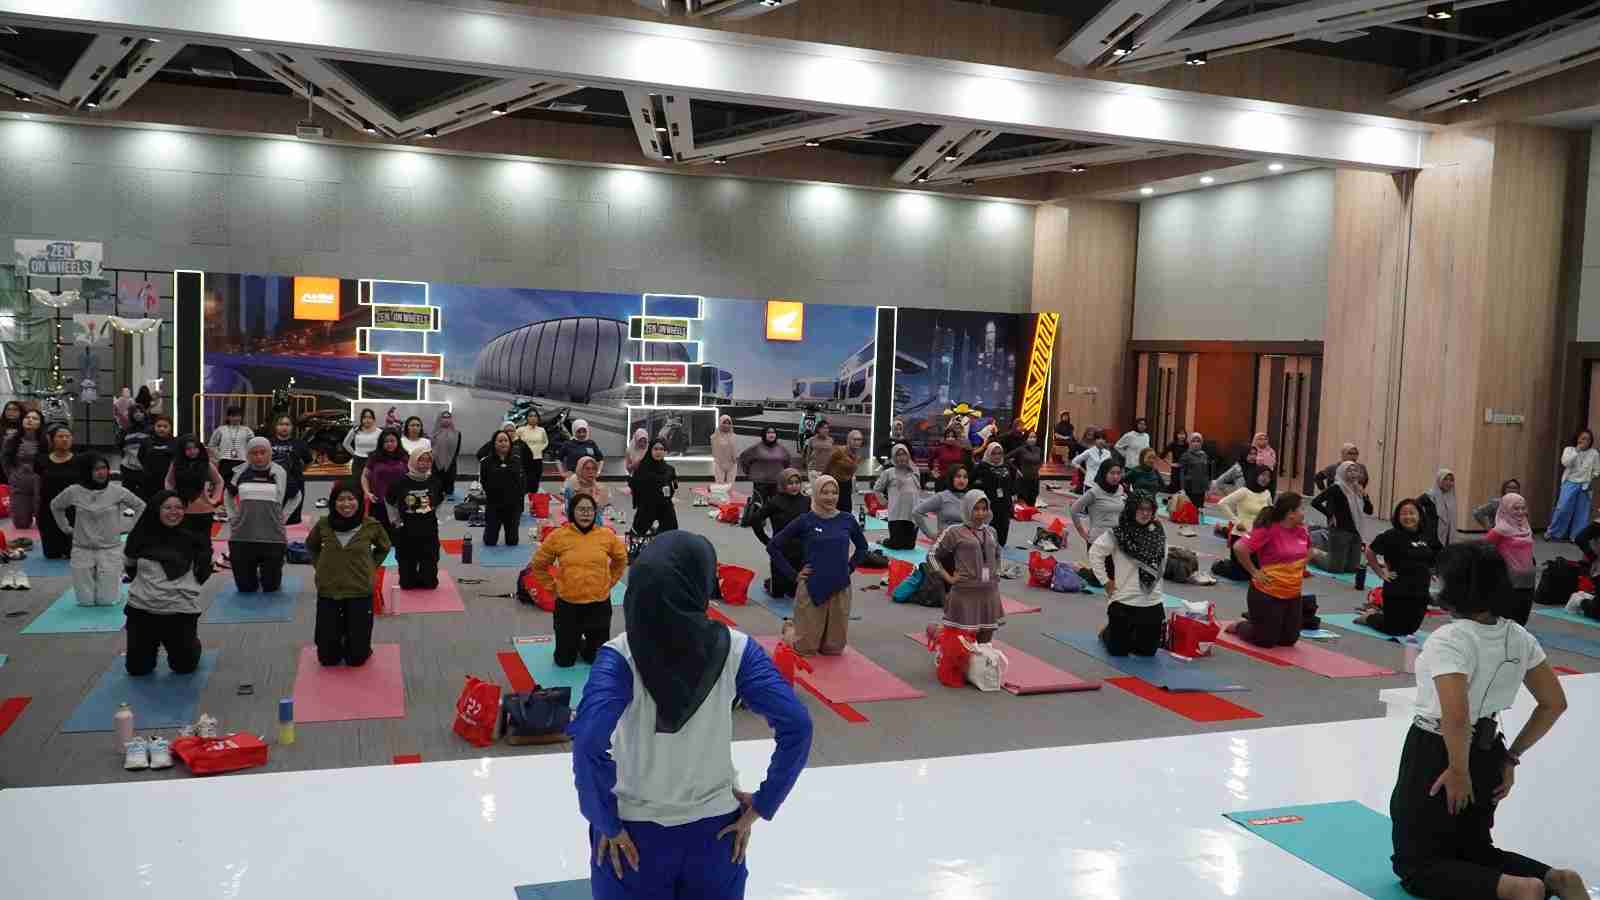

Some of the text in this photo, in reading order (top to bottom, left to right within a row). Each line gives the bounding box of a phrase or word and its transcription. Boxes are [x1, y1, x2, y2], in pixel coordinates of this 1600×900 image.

[50, 244, 73, 258] ZEN
[31, 260, 89, 274] ON WHEELS
